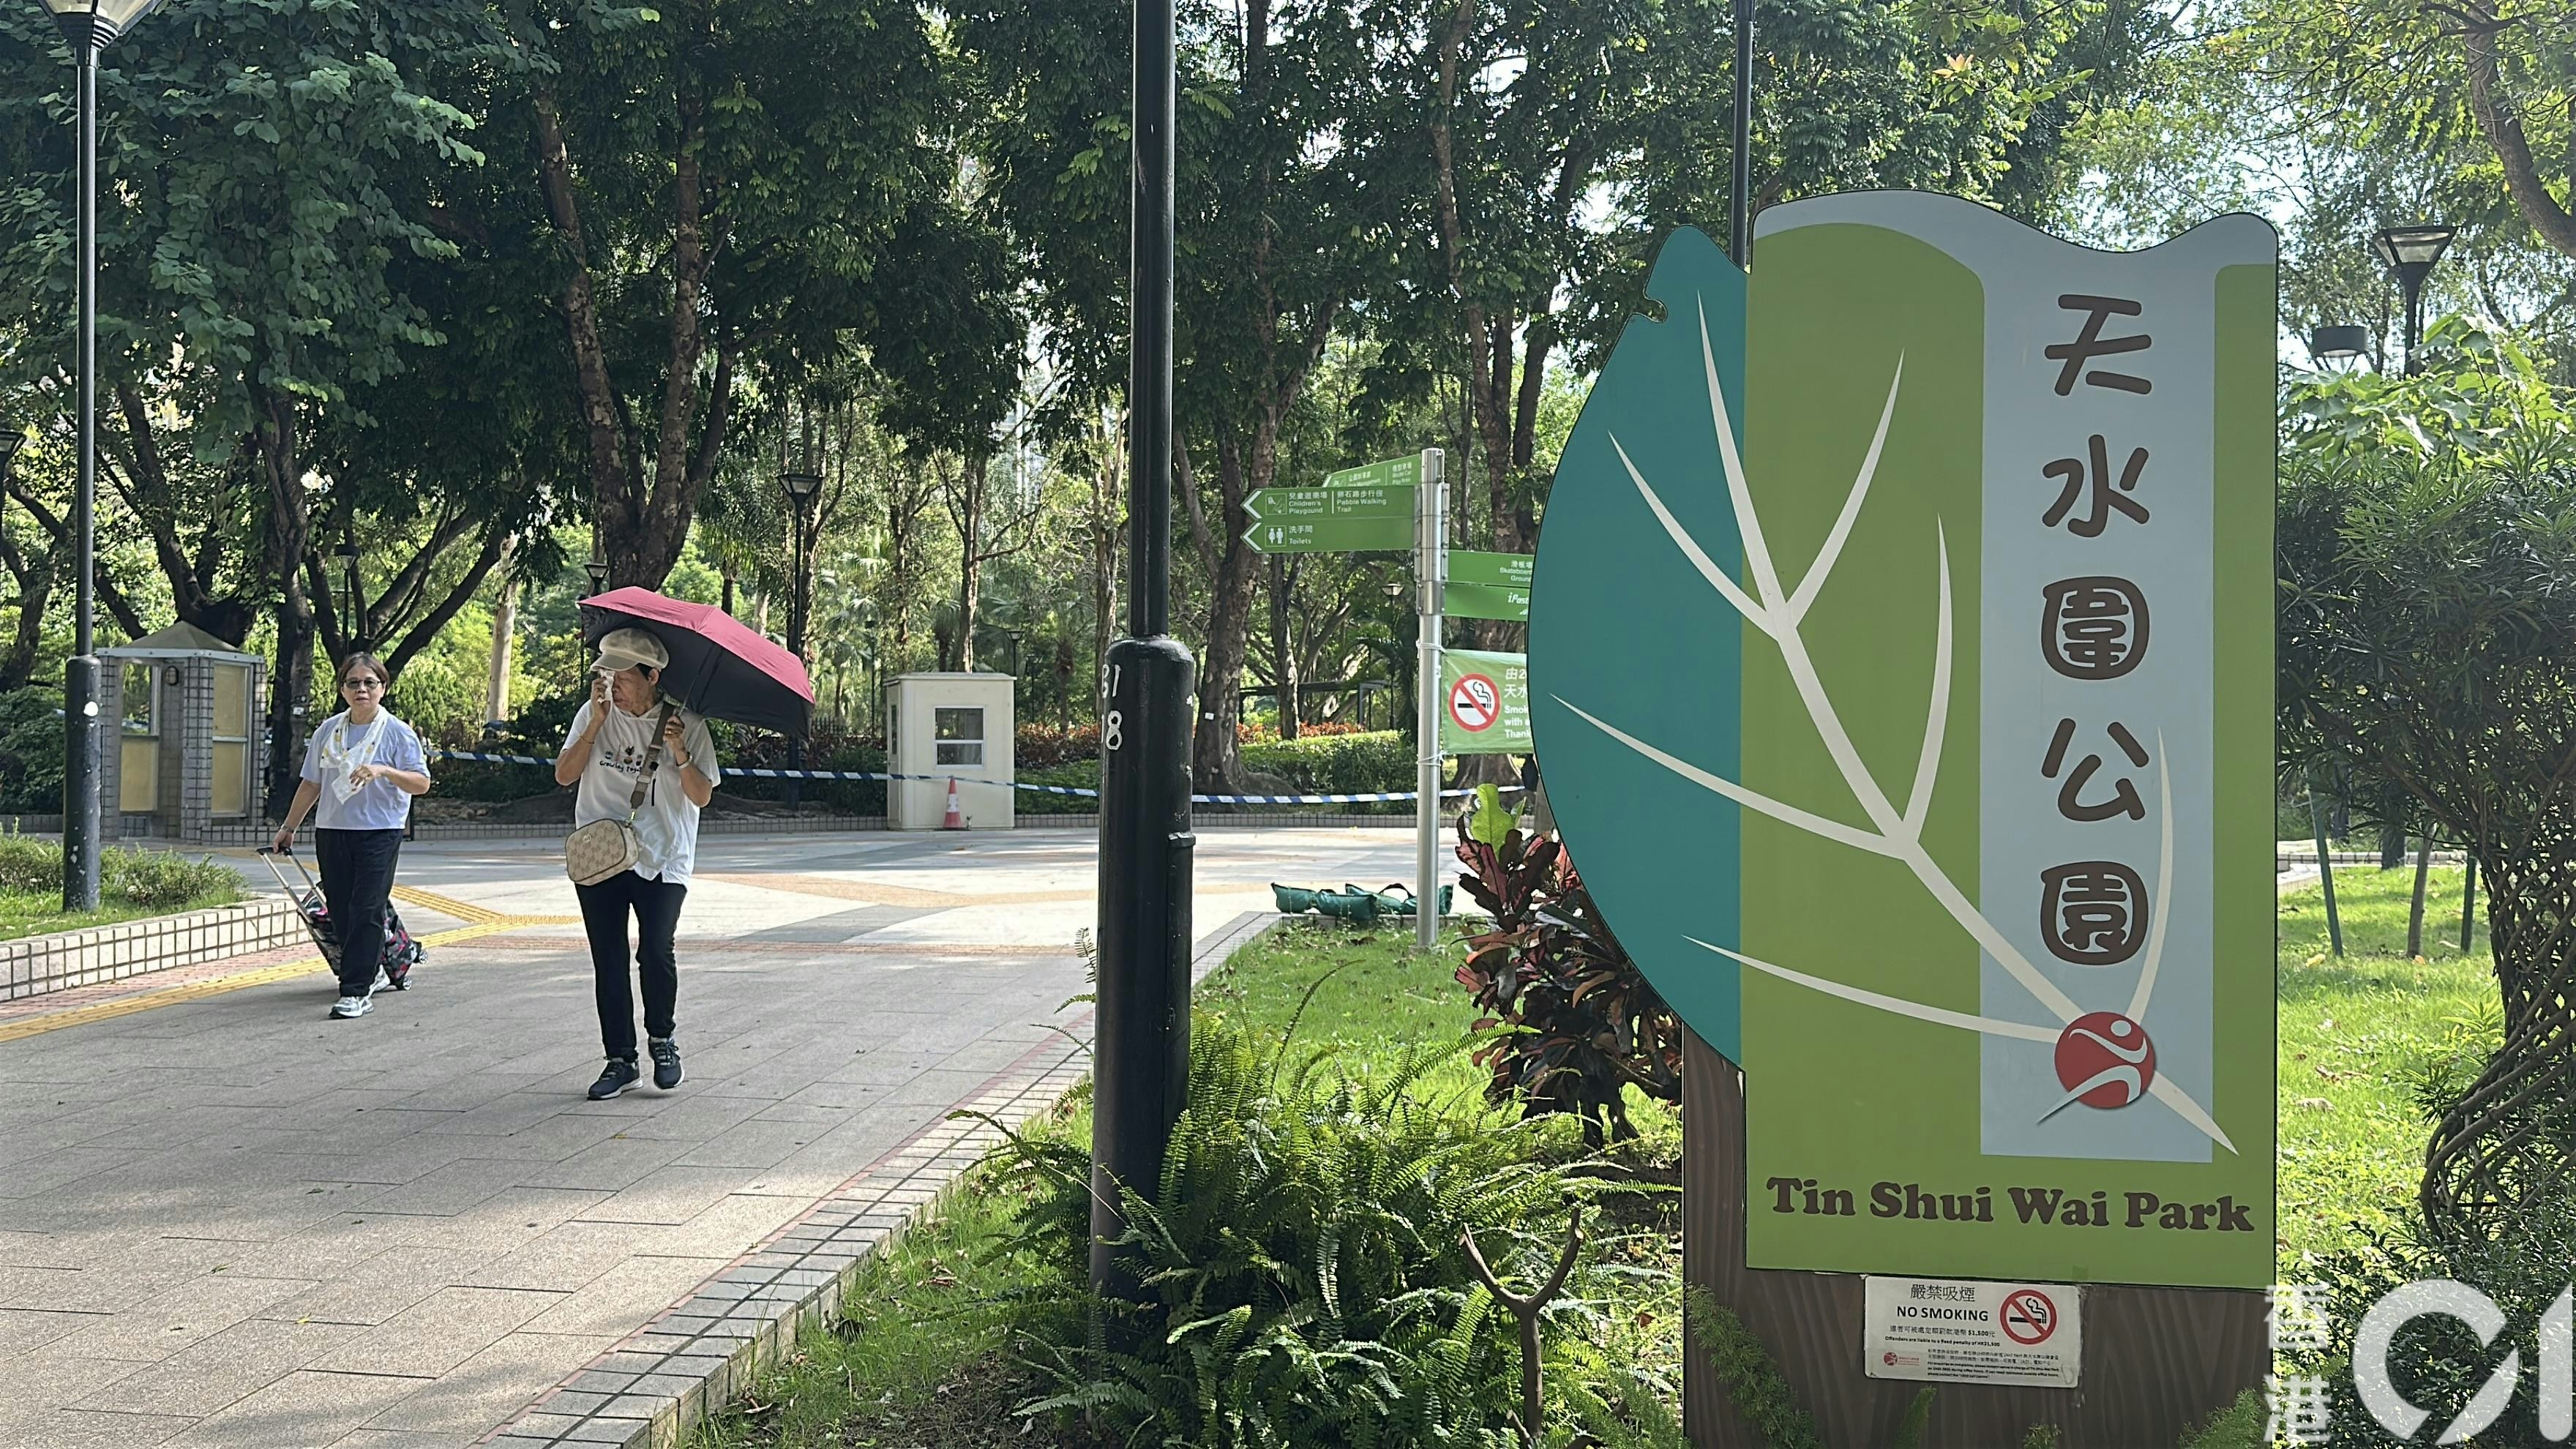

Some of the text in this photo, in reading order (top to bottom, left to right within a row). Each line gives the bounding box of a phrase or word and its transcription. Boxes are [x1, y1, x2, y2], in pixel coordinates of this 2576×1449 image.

[2040, 293, 2152, 966] 天水圍公園
[1505, 717, 1522, 726] with
[1766, 1177, 2255, 1232] Tin Shui Wai Park
[1910, 1284, 1975, 1302] 嚴禁吸煙
[1897, 1306, 1988, 1322] NO SMOKING
